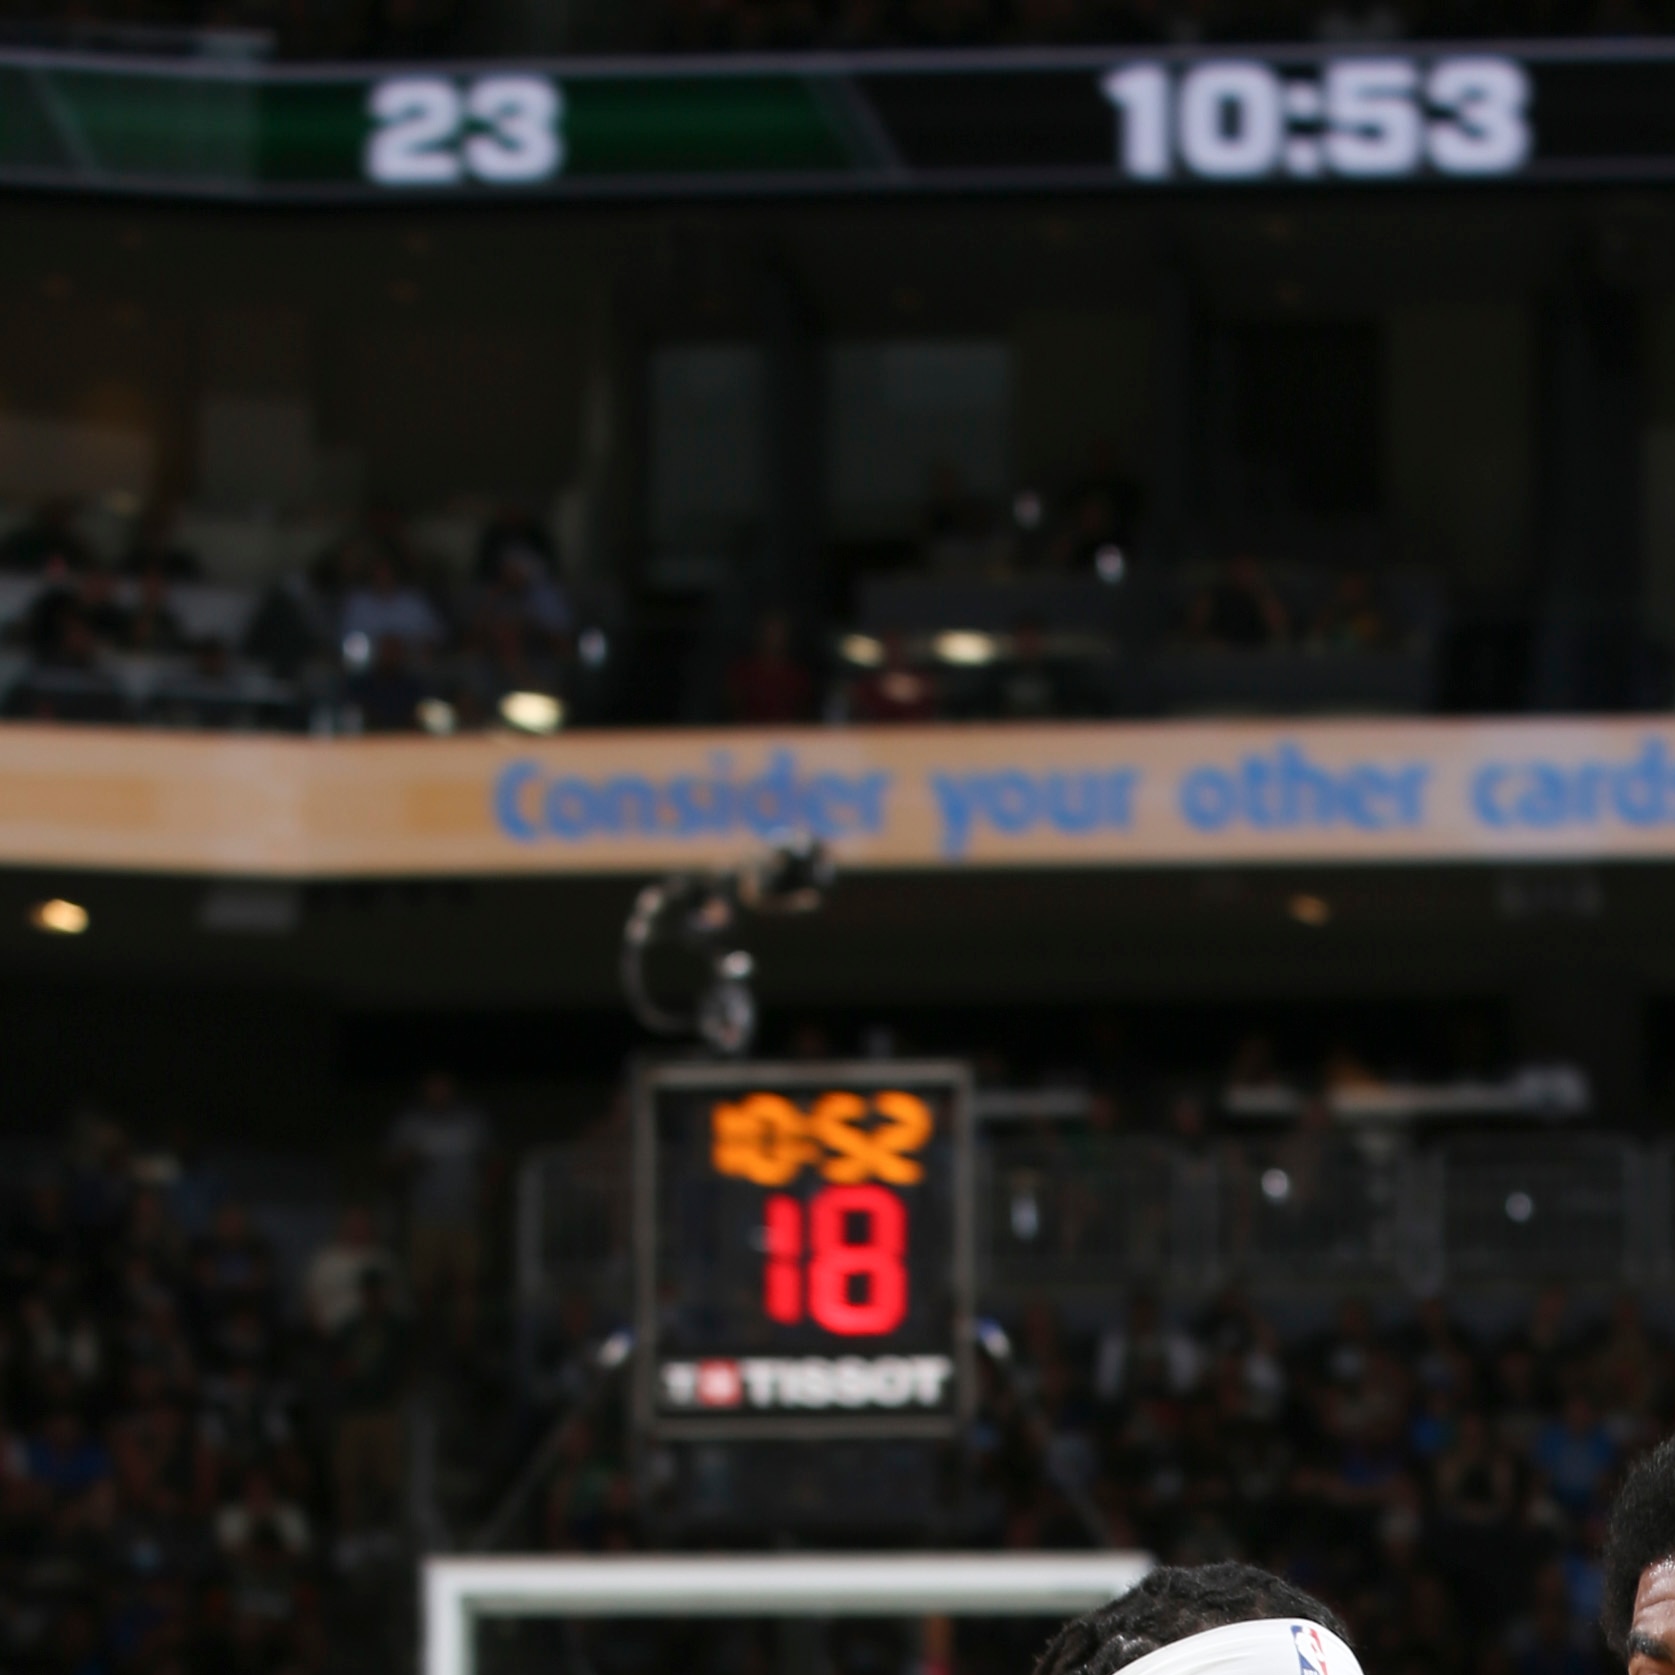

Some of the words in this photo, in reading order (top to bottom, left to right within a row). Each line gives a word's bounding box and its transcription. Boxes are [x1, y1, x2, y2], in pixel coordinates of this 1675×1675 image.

[371, 76, 559, 182] 23
[1107, 58, 1529, 176] 10:53
[495, 750, 888, 842] Consider
[930, 765, 1141, 858] your
[1176, 740, 1430, 834] other
[764, 1182, 910, 1336] 18
[742, 1355, 952, 1408] TISSOT
